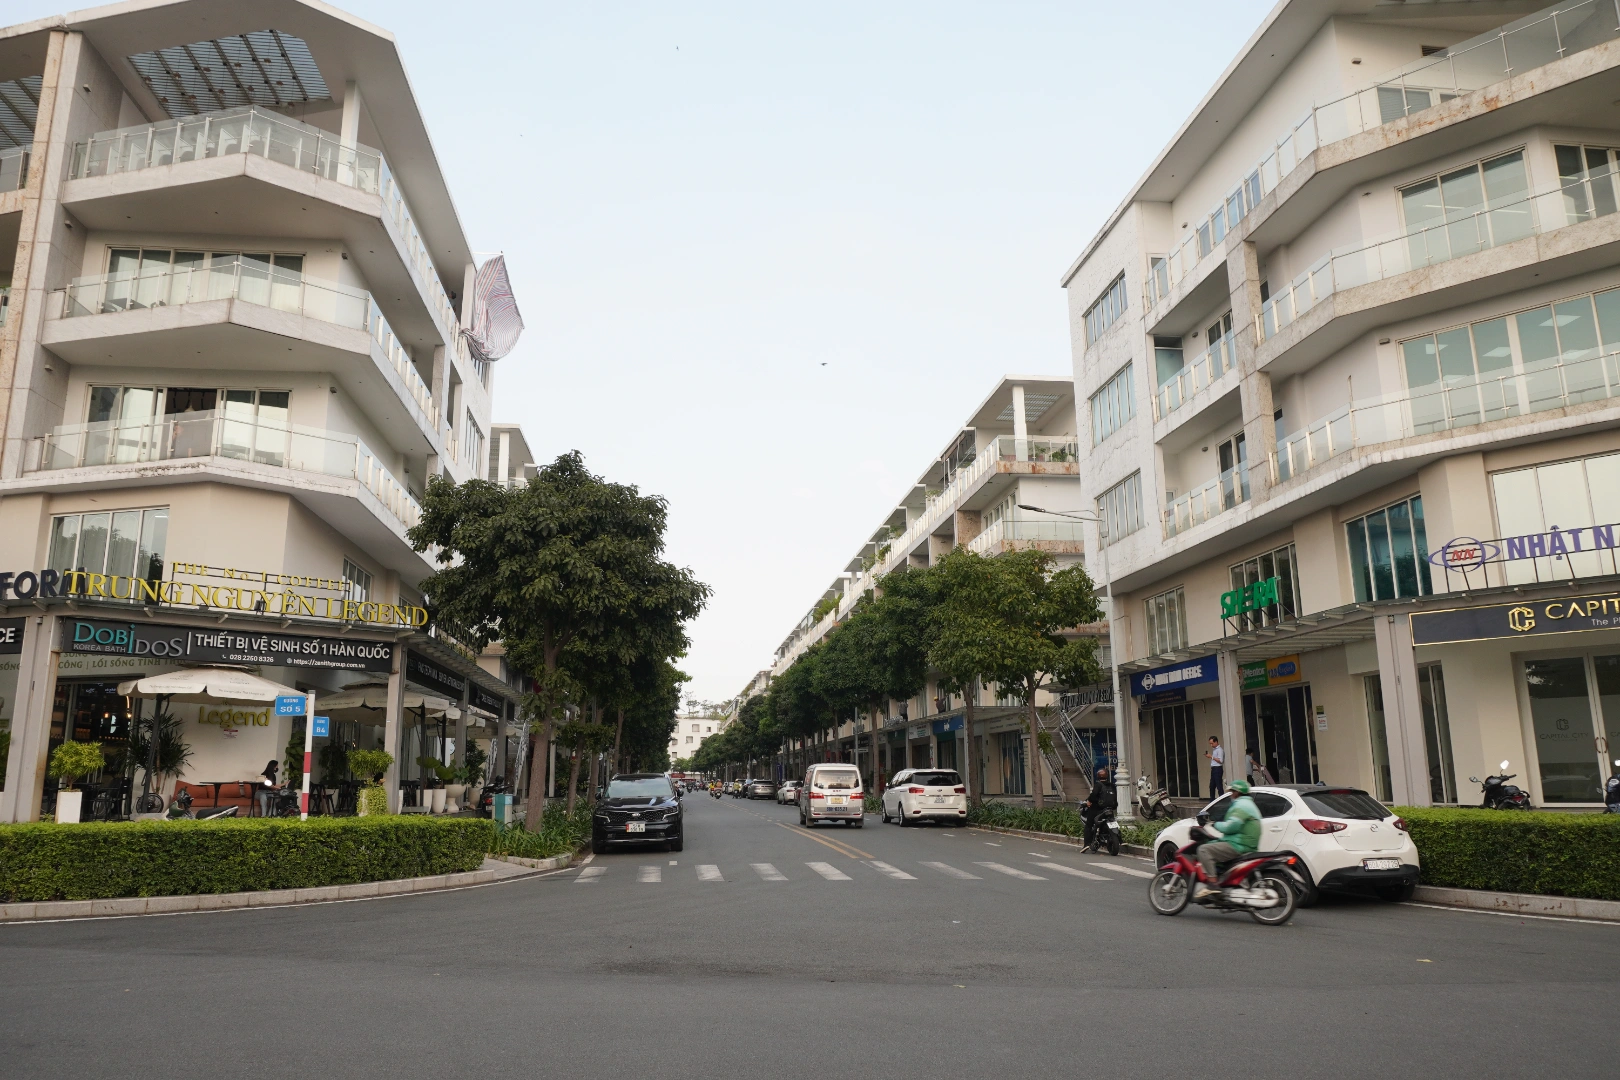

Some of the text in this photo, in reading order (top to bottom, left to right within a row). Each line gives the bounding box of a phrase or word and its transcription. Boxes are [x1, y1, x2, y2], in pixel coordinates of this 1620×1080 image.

[1506, 524, 1620, 561] NHẬT N
[171, 561, 208, 577] THE
[64, 570, 429, 627] TRUNG NGUYÊN LEGEND
[1591, 618, 1609, 626] The
[73, 643, 127, 653] KOREA BATH
[195, 631, 390, 659] THIẾT BỊ VỆ SINH SỐ 1 HÀN QUỐC
[198, 706, 271, 729] Legend
[280, 704, 301, 713] SỐ 5
